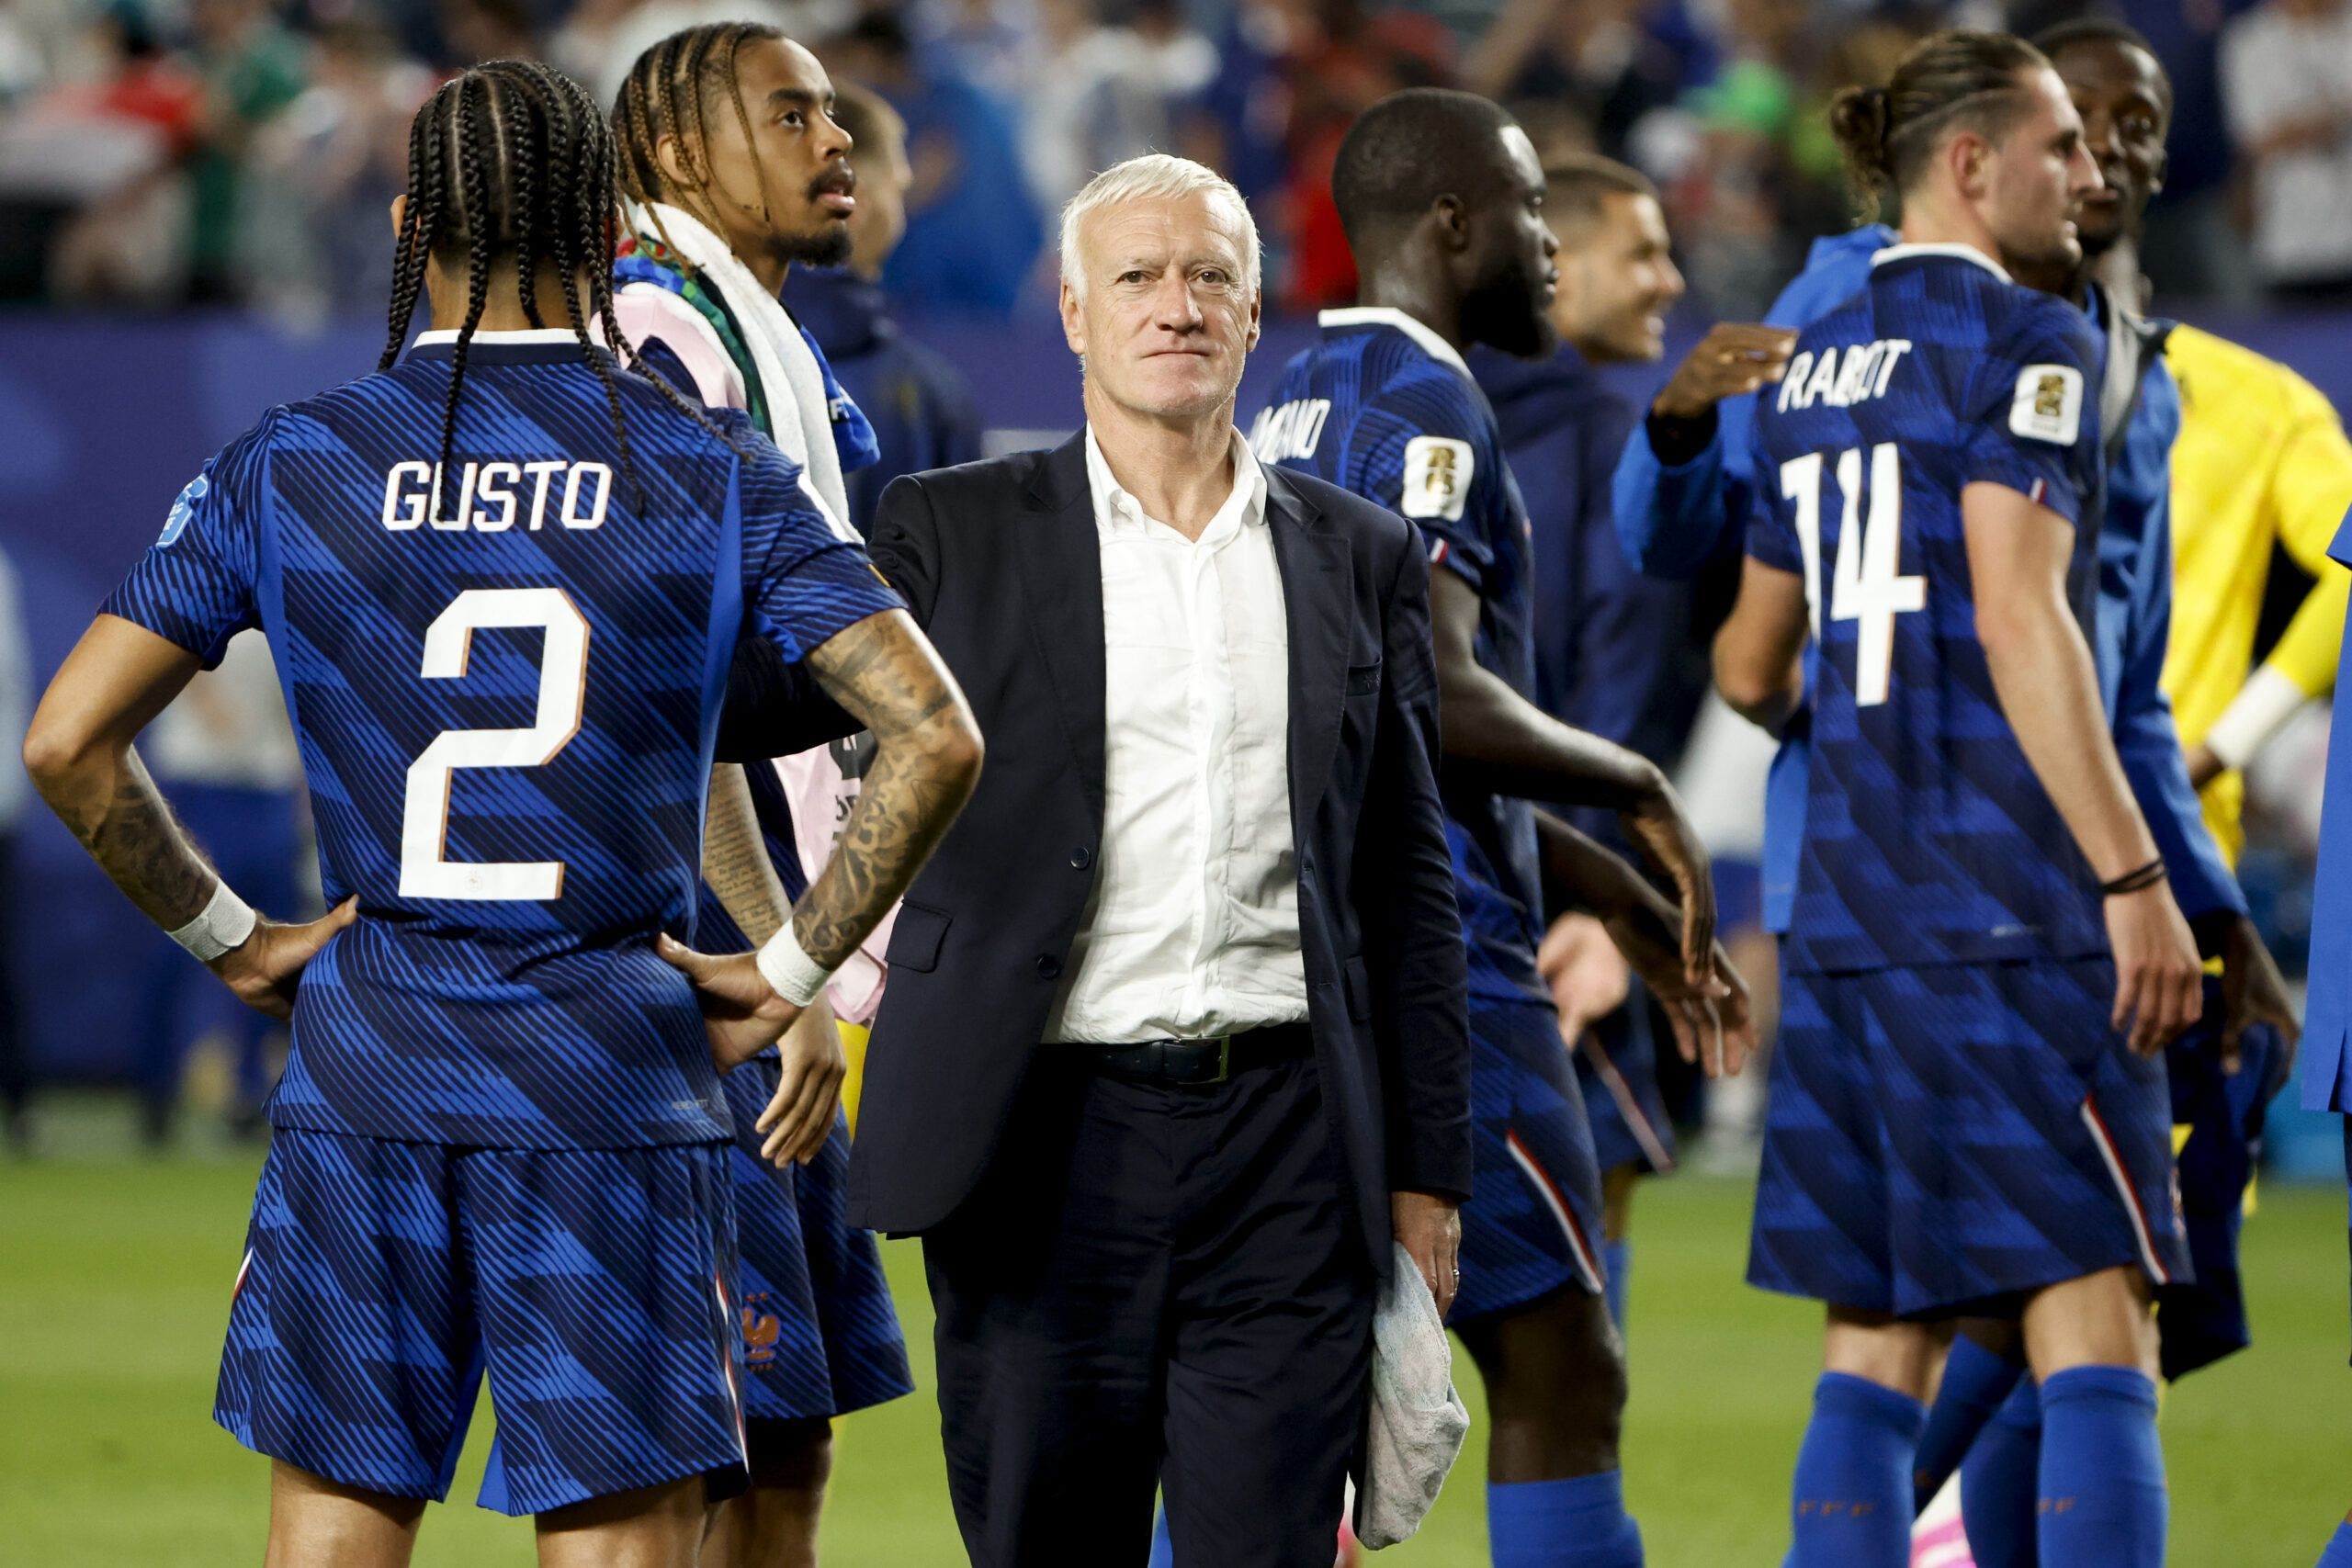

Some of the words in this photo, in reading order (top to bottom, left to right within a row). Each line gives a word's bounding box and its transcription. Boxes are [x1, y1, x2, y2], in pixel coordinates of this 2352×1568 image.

[382, 460, 613, 532] GUSTO
[1780, 442, 1928, 706] 14
[398, 588, 591, 900] 2
